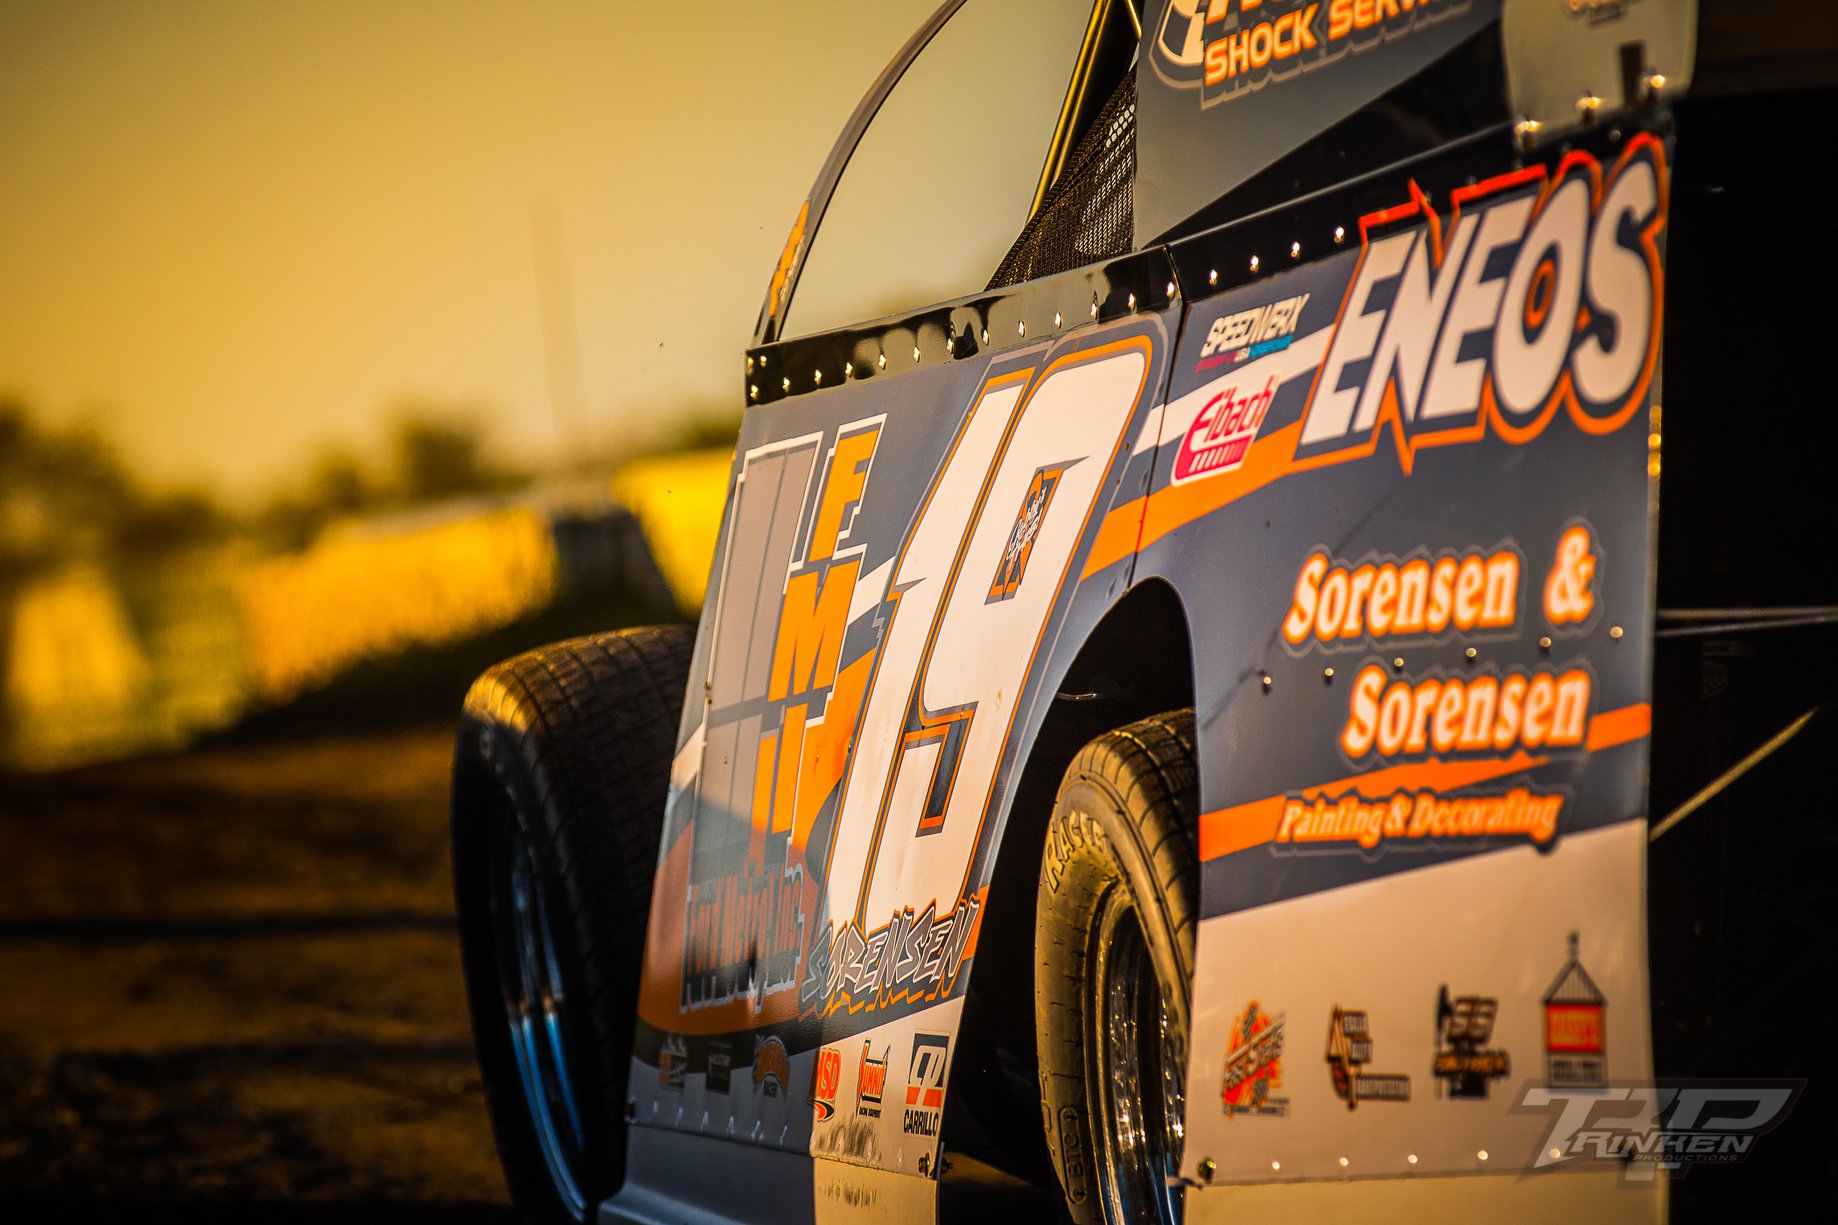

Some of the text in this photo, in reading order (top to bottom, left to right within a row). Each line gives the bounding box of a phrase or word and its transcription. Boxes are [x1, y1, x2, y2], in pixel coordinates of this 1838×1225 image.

[1204, 4, 1318, 87] SHOCK
[1298, 157, 1659, 448] ENEOS
[1186, 373, 1277, 445] Eibach
[1281, 525, 1597, 644] Sorensen &
[824, 335, 1152, 935] 19
[1340, 663, 1592, 758] Sorensen
[801, 898, 980, 1003] SORENSEN
[903, 1108, 939, 1137] CARRILLO
